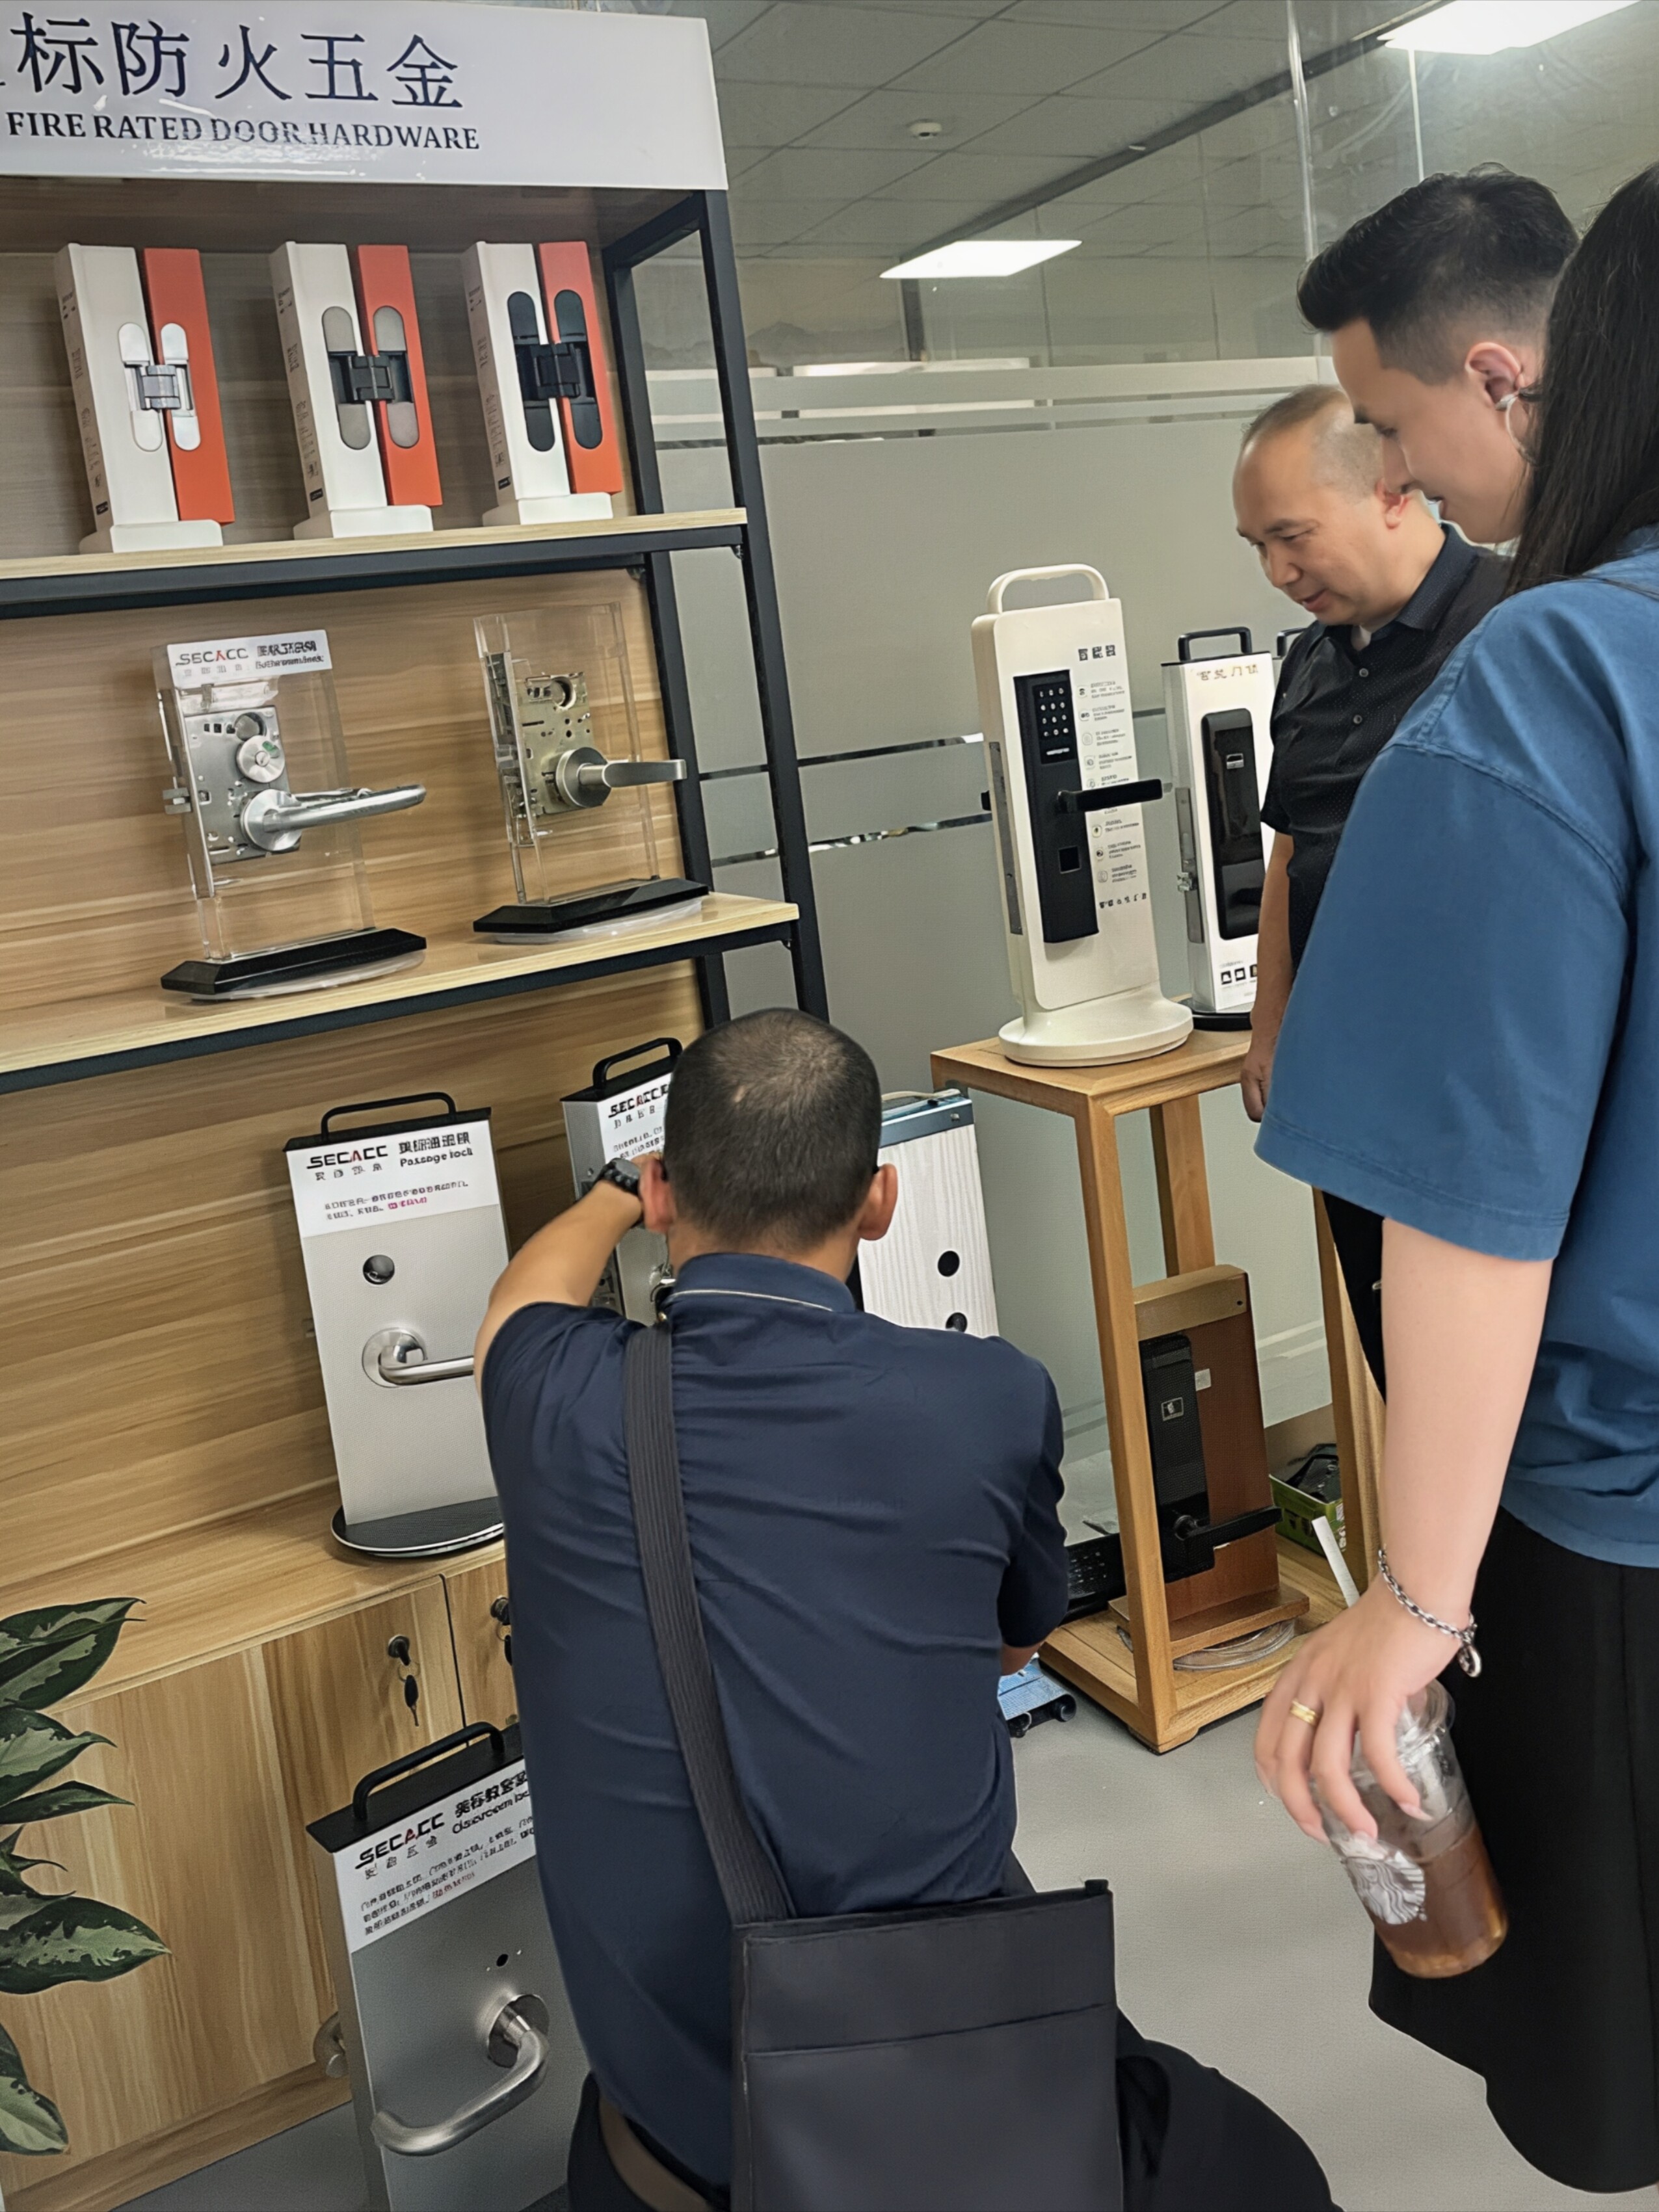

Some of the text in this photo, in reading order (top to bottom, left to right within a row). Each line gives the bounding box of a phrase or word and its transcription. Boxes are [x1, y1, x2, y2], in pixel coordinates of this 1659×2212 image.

[0, 12, 463, 108] 标防火五金
[6, 112, 480, 150] FIRE RATED DOOR HARDWARE
[176, 648, 248, 666] SECACC
[306, 1145, 388, 1169] SECACC
[354, 1812, 445, 1869] SECACC
